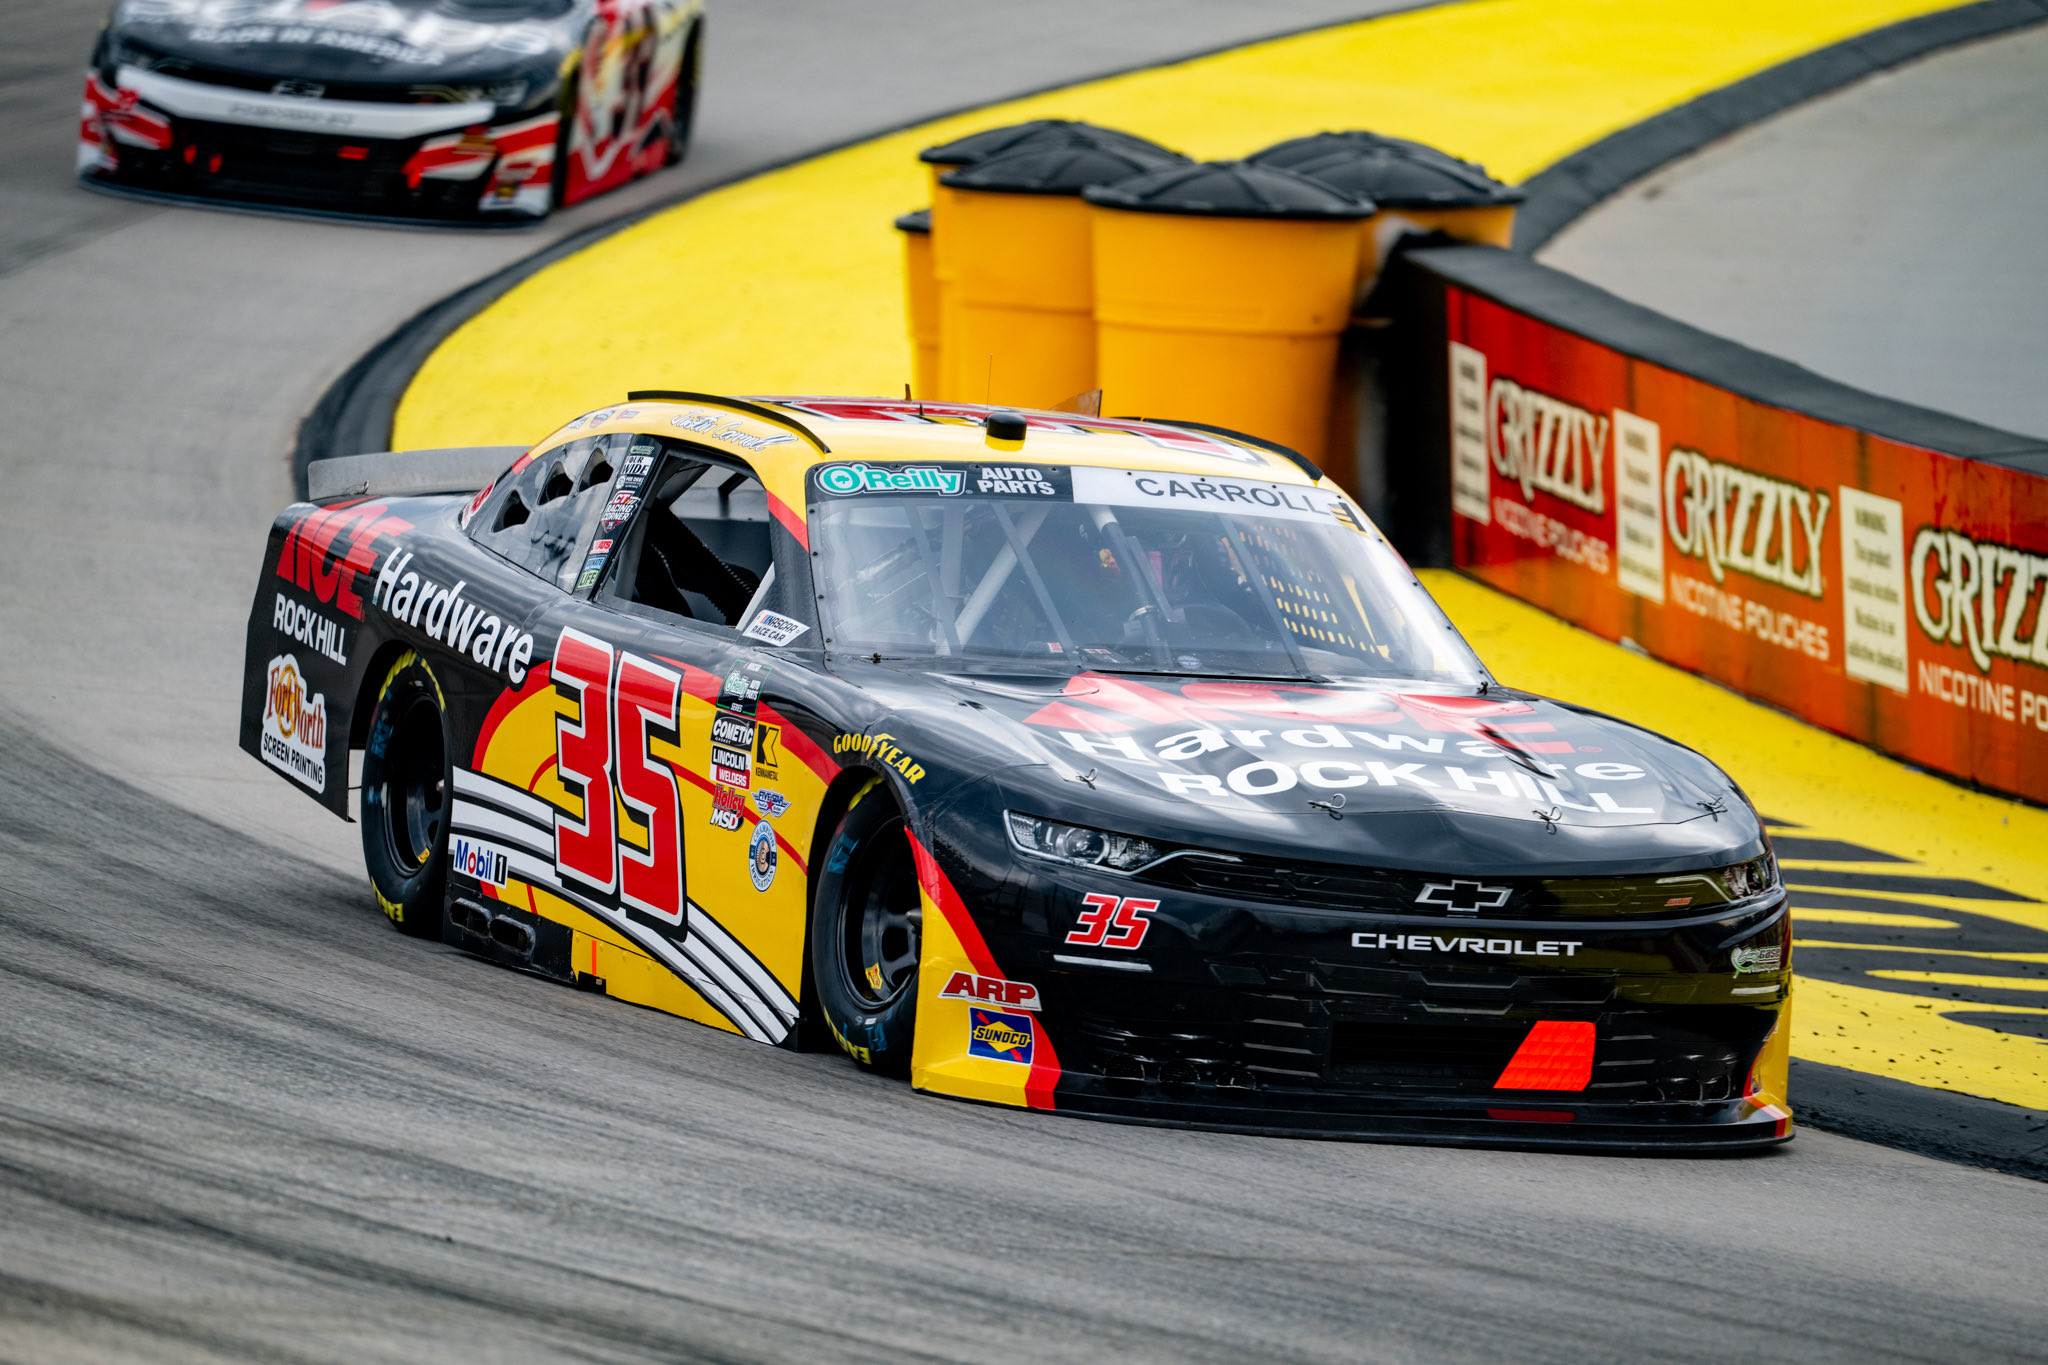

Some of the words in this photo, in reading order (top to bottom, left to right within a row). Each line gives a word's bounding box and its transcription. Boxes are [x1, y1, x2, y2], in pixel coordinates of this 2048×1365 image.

[1490, 378, 1609, 514] GRIZZLY
[820, 464, 960, 493] O'Reilly
[977, 480, 1056, 495] PARTS
[981, 467, 1043, 481] AUTO
[1135, 478, 1332, 515] CARROLL
[1664, 448, 1830, 599] GRIZZLY
[276, 495, 416, 622] ACE
[273, 592, 314, 649] ROCK
[315, 614, 347, 666] HILL
[373, 546, 534, 686] Hardware
[752, 625, 770, 637] RACE
[768, 630, 786, 642] CAR
[765, 615, 798, 633] NASCAR
[1744, 600, 1830, 661] POUCHES
[1918, 660, 2015, 721] NICOTINE
[712, 718, 754, 745] COMETIC
[263, 732, 290, 766] SCREEN
[291, 748, 323, 785] PRINTING
[713, 748, 745, 770] LINCOLN
[1056, 723, 1647, 782] Hardware
[550, 625, 684, 928] 35
[718, 768, 748, 786] WELDERS
[1158, 758, 1428, 800] ROCK
[1444, 765, 1656, 815] HILL
[710, 808, 739, 831] MSD
[713, 784, 745, 818] Holley
[455, 839, 493, 881] Mobil
[1064, 892, 1161, 950] 35
[1351, 932, 1583, 956] CHEVROLET
[942, 972, 1036, 1004] ARP
[976, 1027, 1028, 1046] SUNOCO
